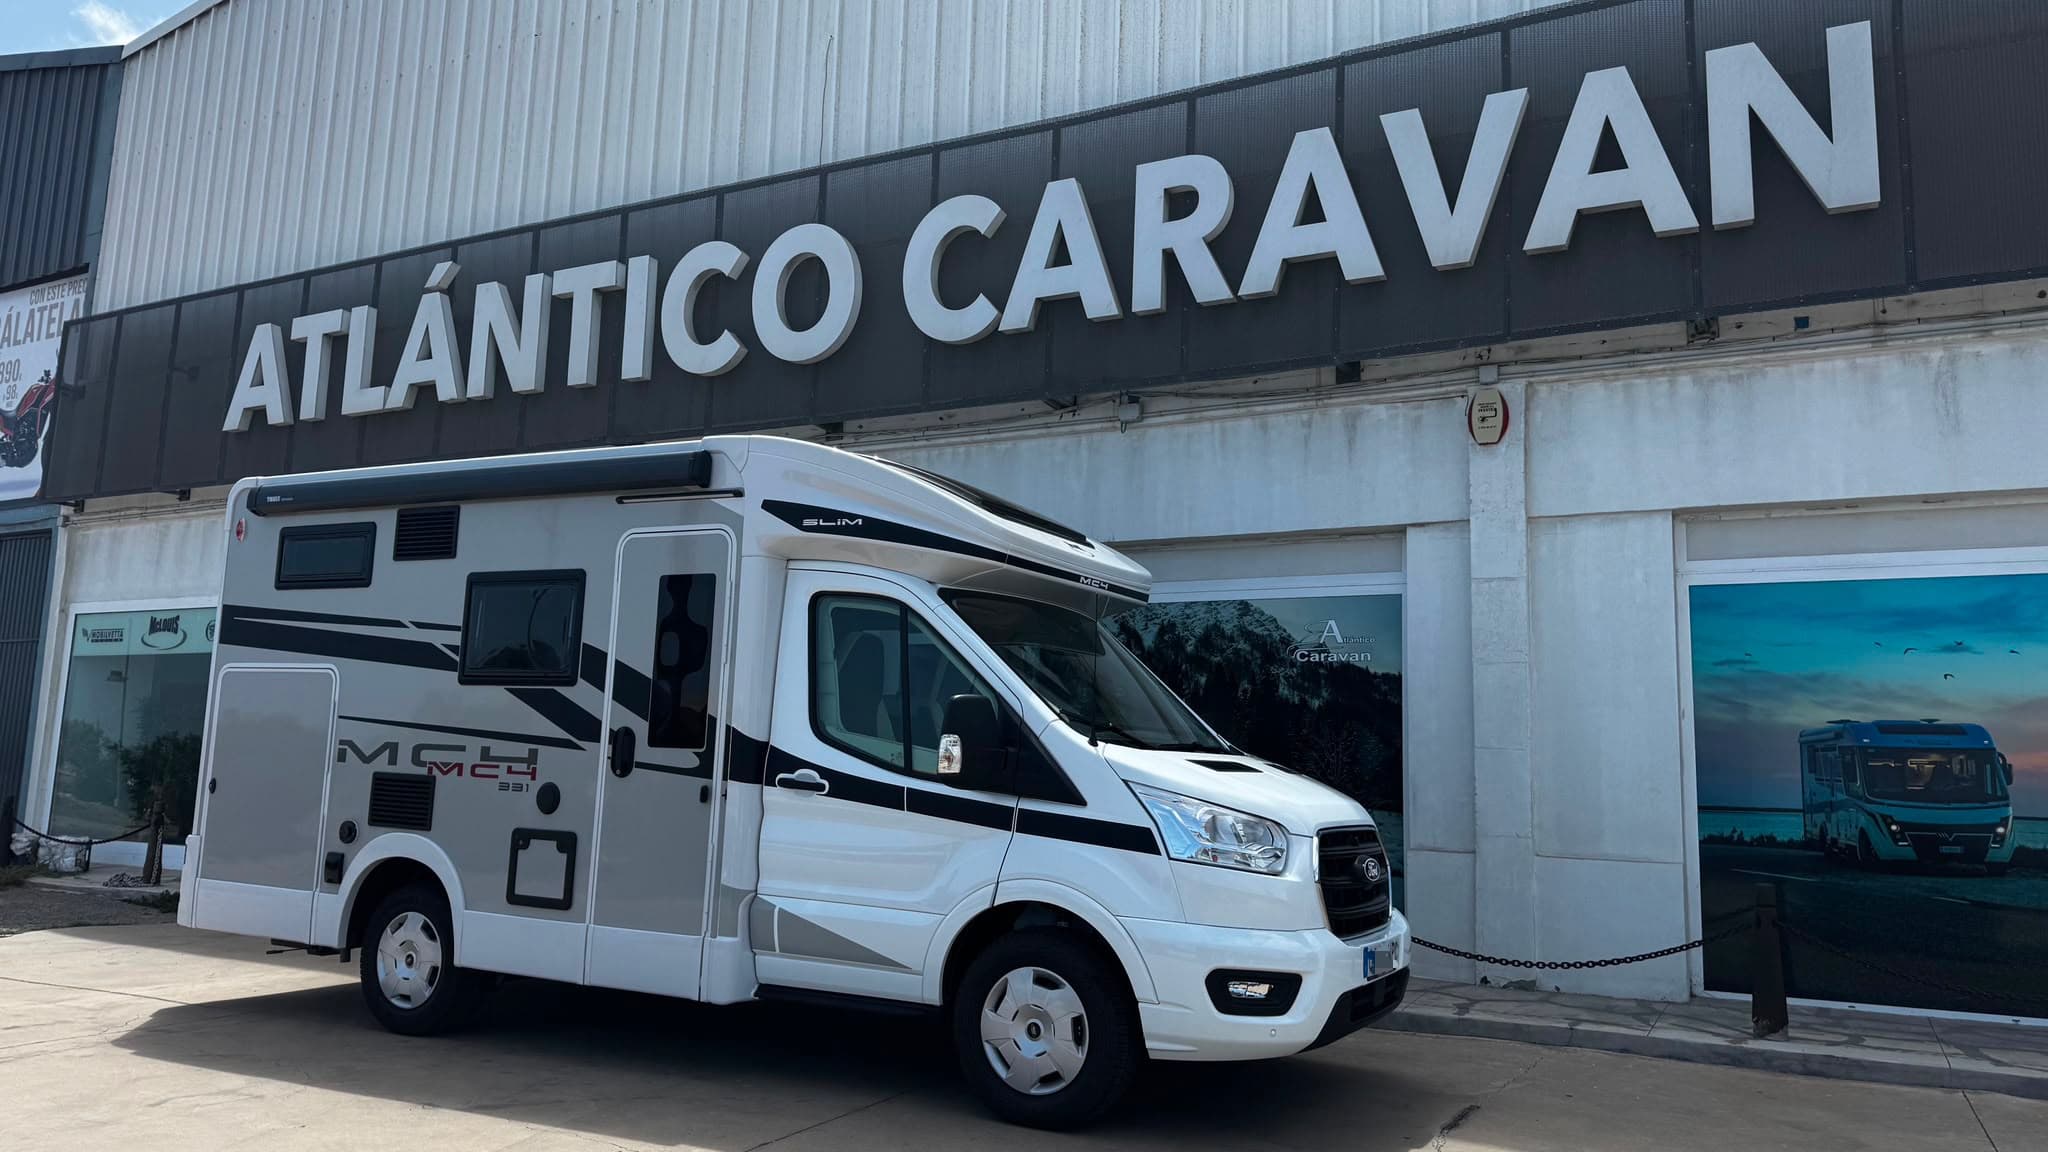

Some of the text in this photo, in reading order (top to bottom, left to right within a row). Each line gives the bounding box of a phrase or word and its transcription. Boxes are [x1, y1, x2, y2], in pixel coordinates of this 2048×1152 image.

[223, 20, 1881, 431] ATLÁNTICO CARAVAN
[30, 287, 46, 305] CON
[47, 282, 67, 301] ESTE
[0, 297, 81, 349] ÁLATELA
[1080, 576, 1109, 590] MC4
[1296, 650, 1371, 662] Caravan
[336, 739, 539, 770] MC4
[427, 761, 537, 781] MC4
[498, 782, 529, 793] 331
